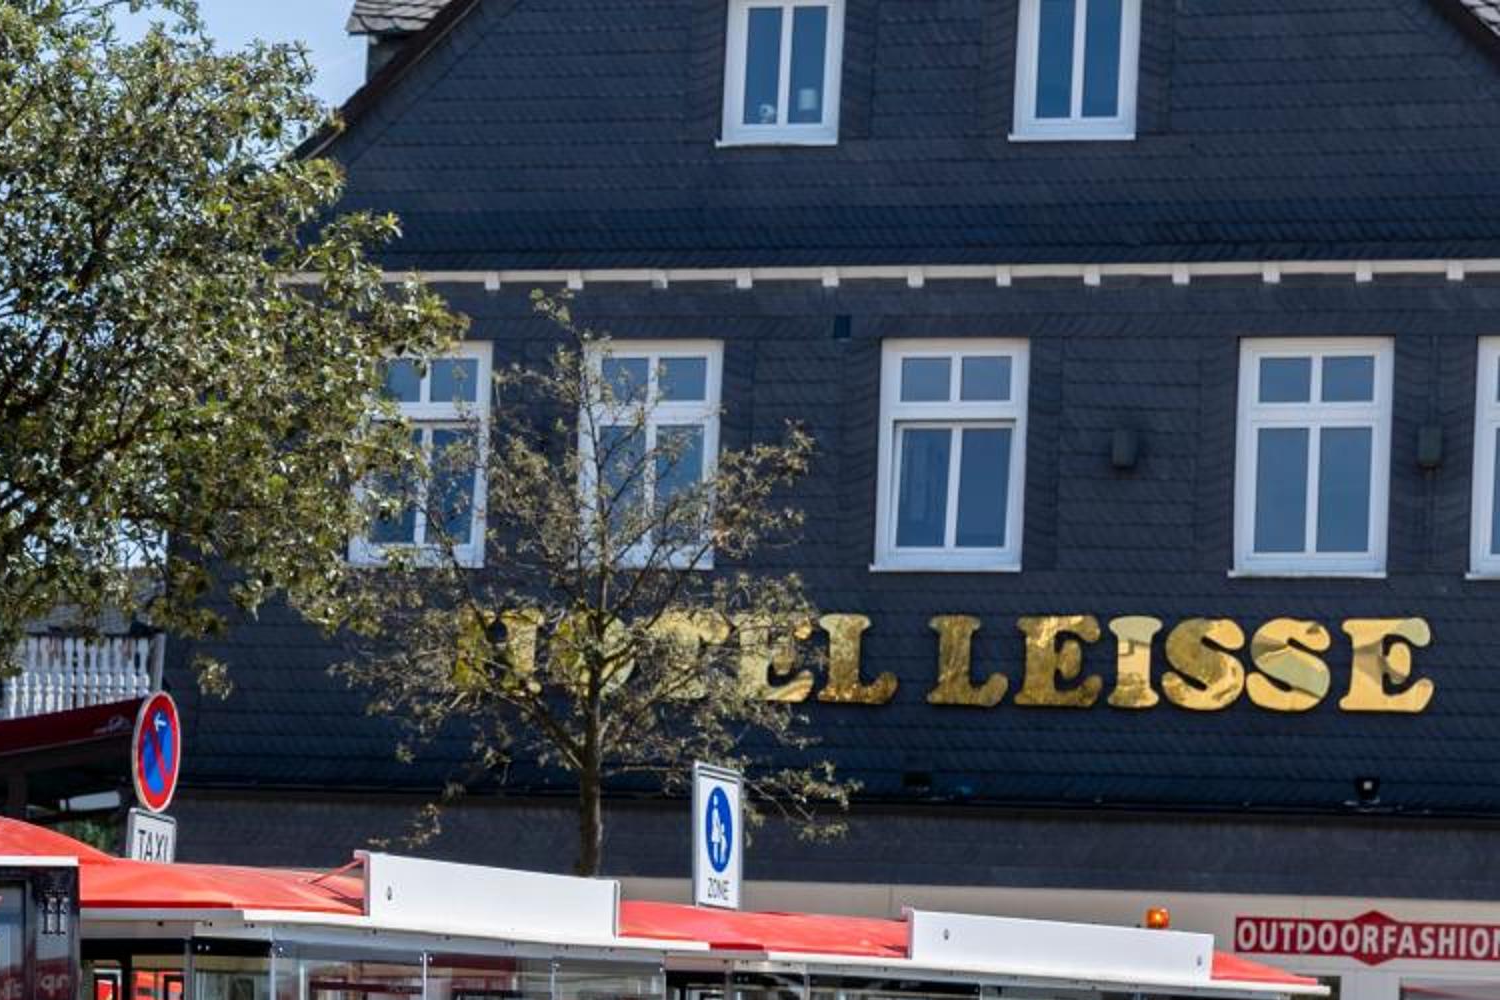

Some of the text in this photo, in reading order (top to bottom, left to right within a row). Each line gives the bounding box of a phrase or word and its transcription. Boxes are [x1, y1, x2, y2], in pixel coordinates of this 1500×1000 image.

[927, 614, 1434, 712] LEISSE
[138, 829, 169, 862] TAXI
[707, 877, 730, 901] ZONE
